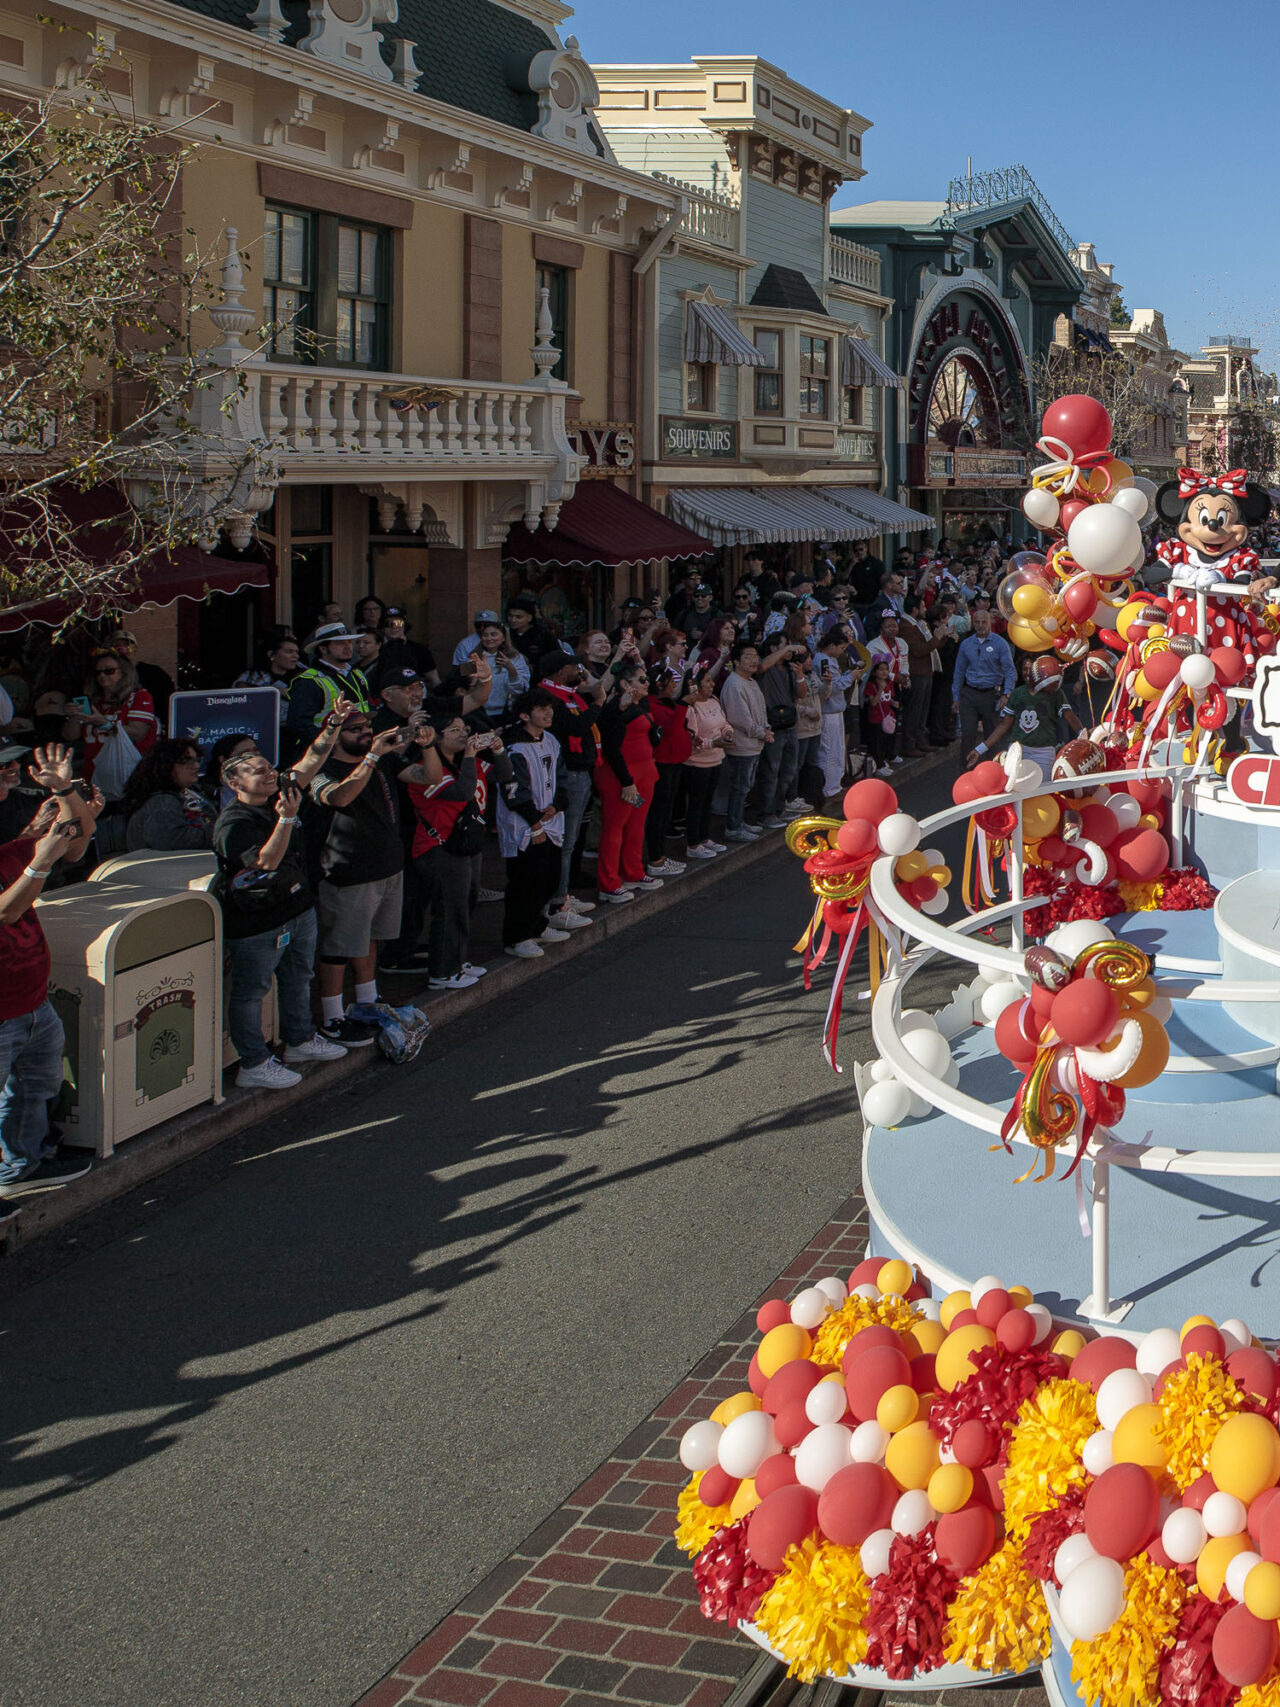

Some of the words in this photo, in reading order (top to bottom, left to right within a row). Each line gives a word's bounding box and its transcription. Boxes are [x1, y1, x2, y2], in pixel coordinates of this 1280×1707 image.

[669, 428, 731, 450] SOUVENIRS
[834, 439, 873, 456] NOVELTIES
[207, 695, 248, 706] Disneyland
[210, 726, 246, 735] MAGIC
[149, 992, 183, 1010] TRASH
